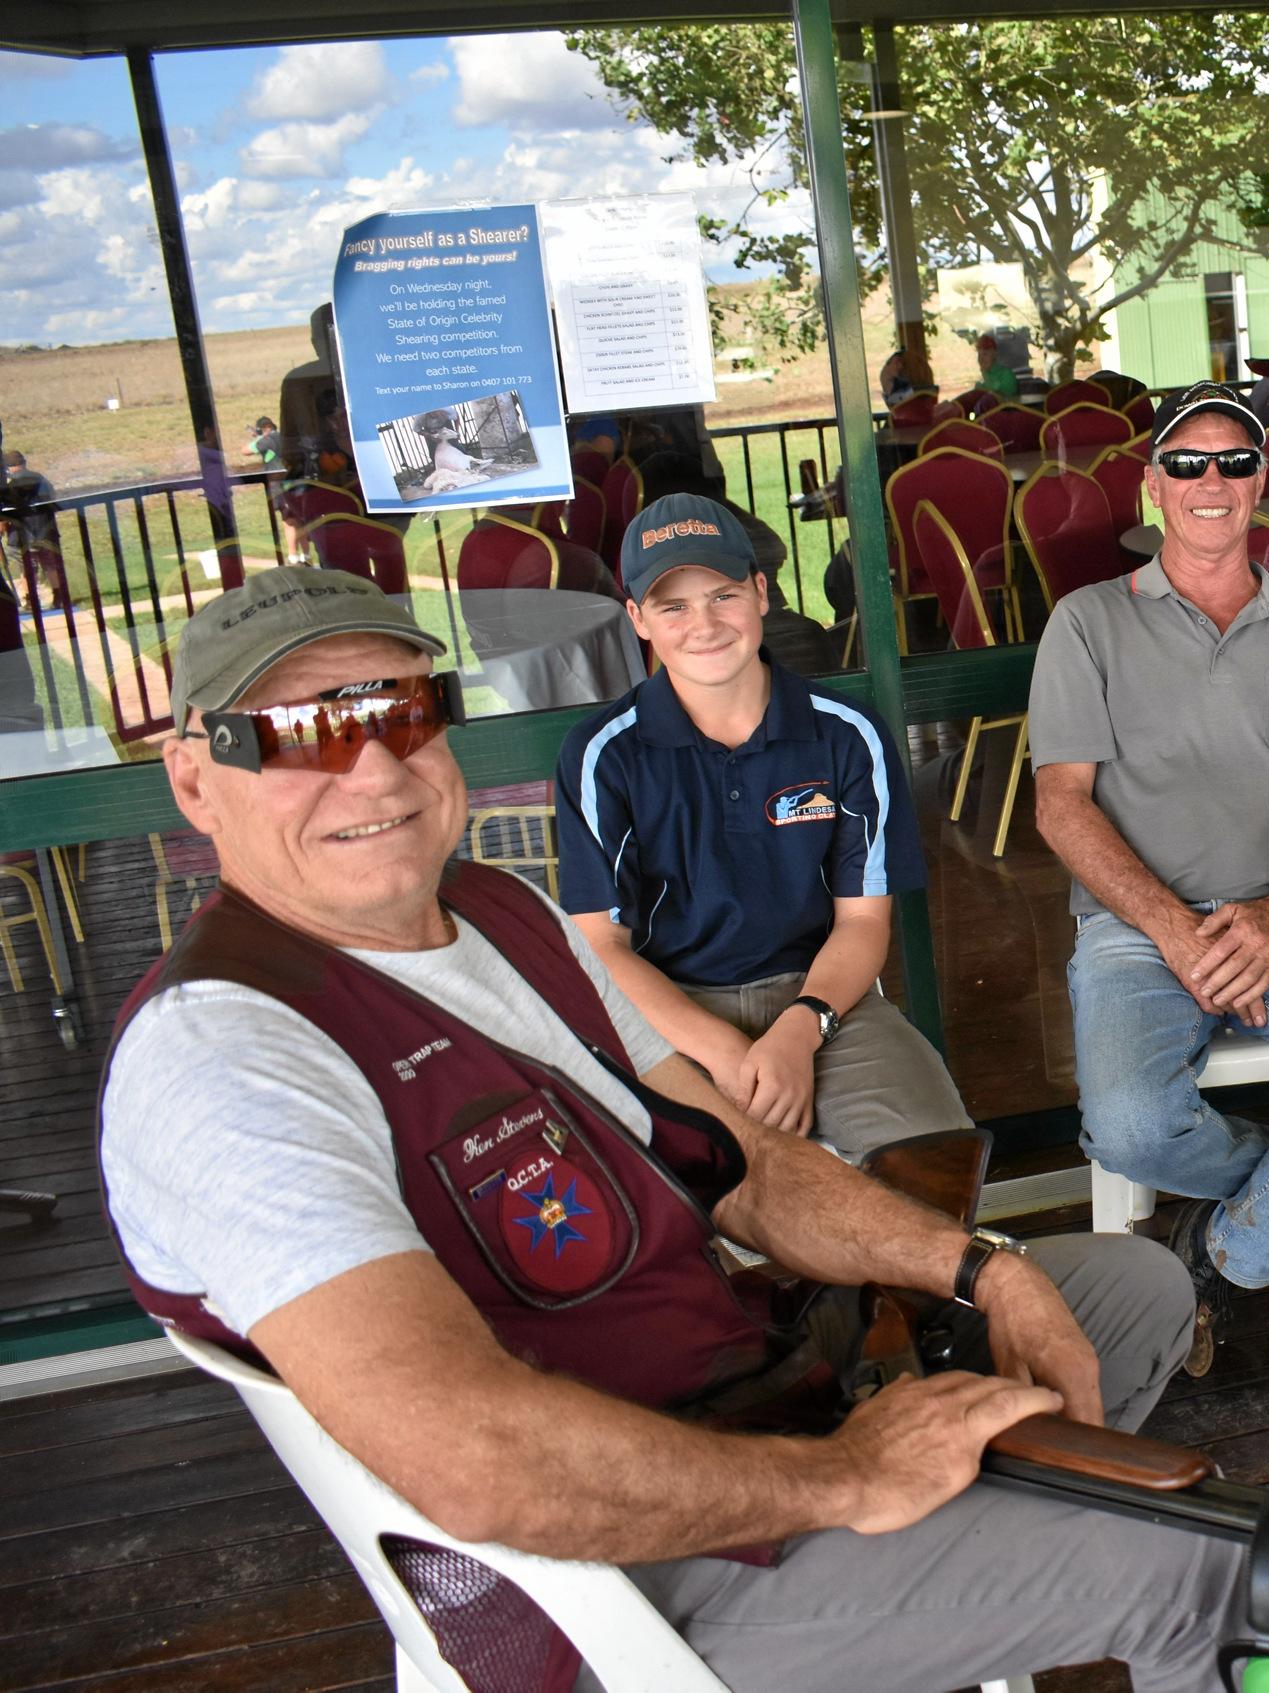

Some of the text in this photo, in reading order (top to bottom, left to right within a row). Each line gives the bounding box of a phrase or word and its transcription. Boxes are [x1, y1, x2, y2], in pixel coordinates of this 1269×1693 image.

[379, 231, 433, 254] yourself
[438, 233, 454, 246] as
[458, 233, 466, 245] a
[469, 226, 528, 244] Shearer?
[354, 251, 517, 272] Bragging rights can be yours!
[390, 284, 405, 294] On
[407, 281, 463, 293] Wednesday
[380, 295, 506, 312] we'll be holding the famed
[388, 312, 503, 329] State of Origin Celebrity
[395, 333, 439, 345] Shearing
[376, 344, 523, 363] We need two competitors from
[425, 365, 450, 376] each
[375, 375, 533, 395] Text your name to Sharon on 0407 101 773
[642, 518, 721, 549] Beretta
[222, 585, 369, 631] LEUPOLD
[337, 680, 384, 698] PILLA
[775, 812, 817, 825] SPORTING
[788, 806, 836, 817] MT LINDESA
[408, 1045, 432, 1065] TRAP
[463, 1108, 543, 1163] Ken Stevens
